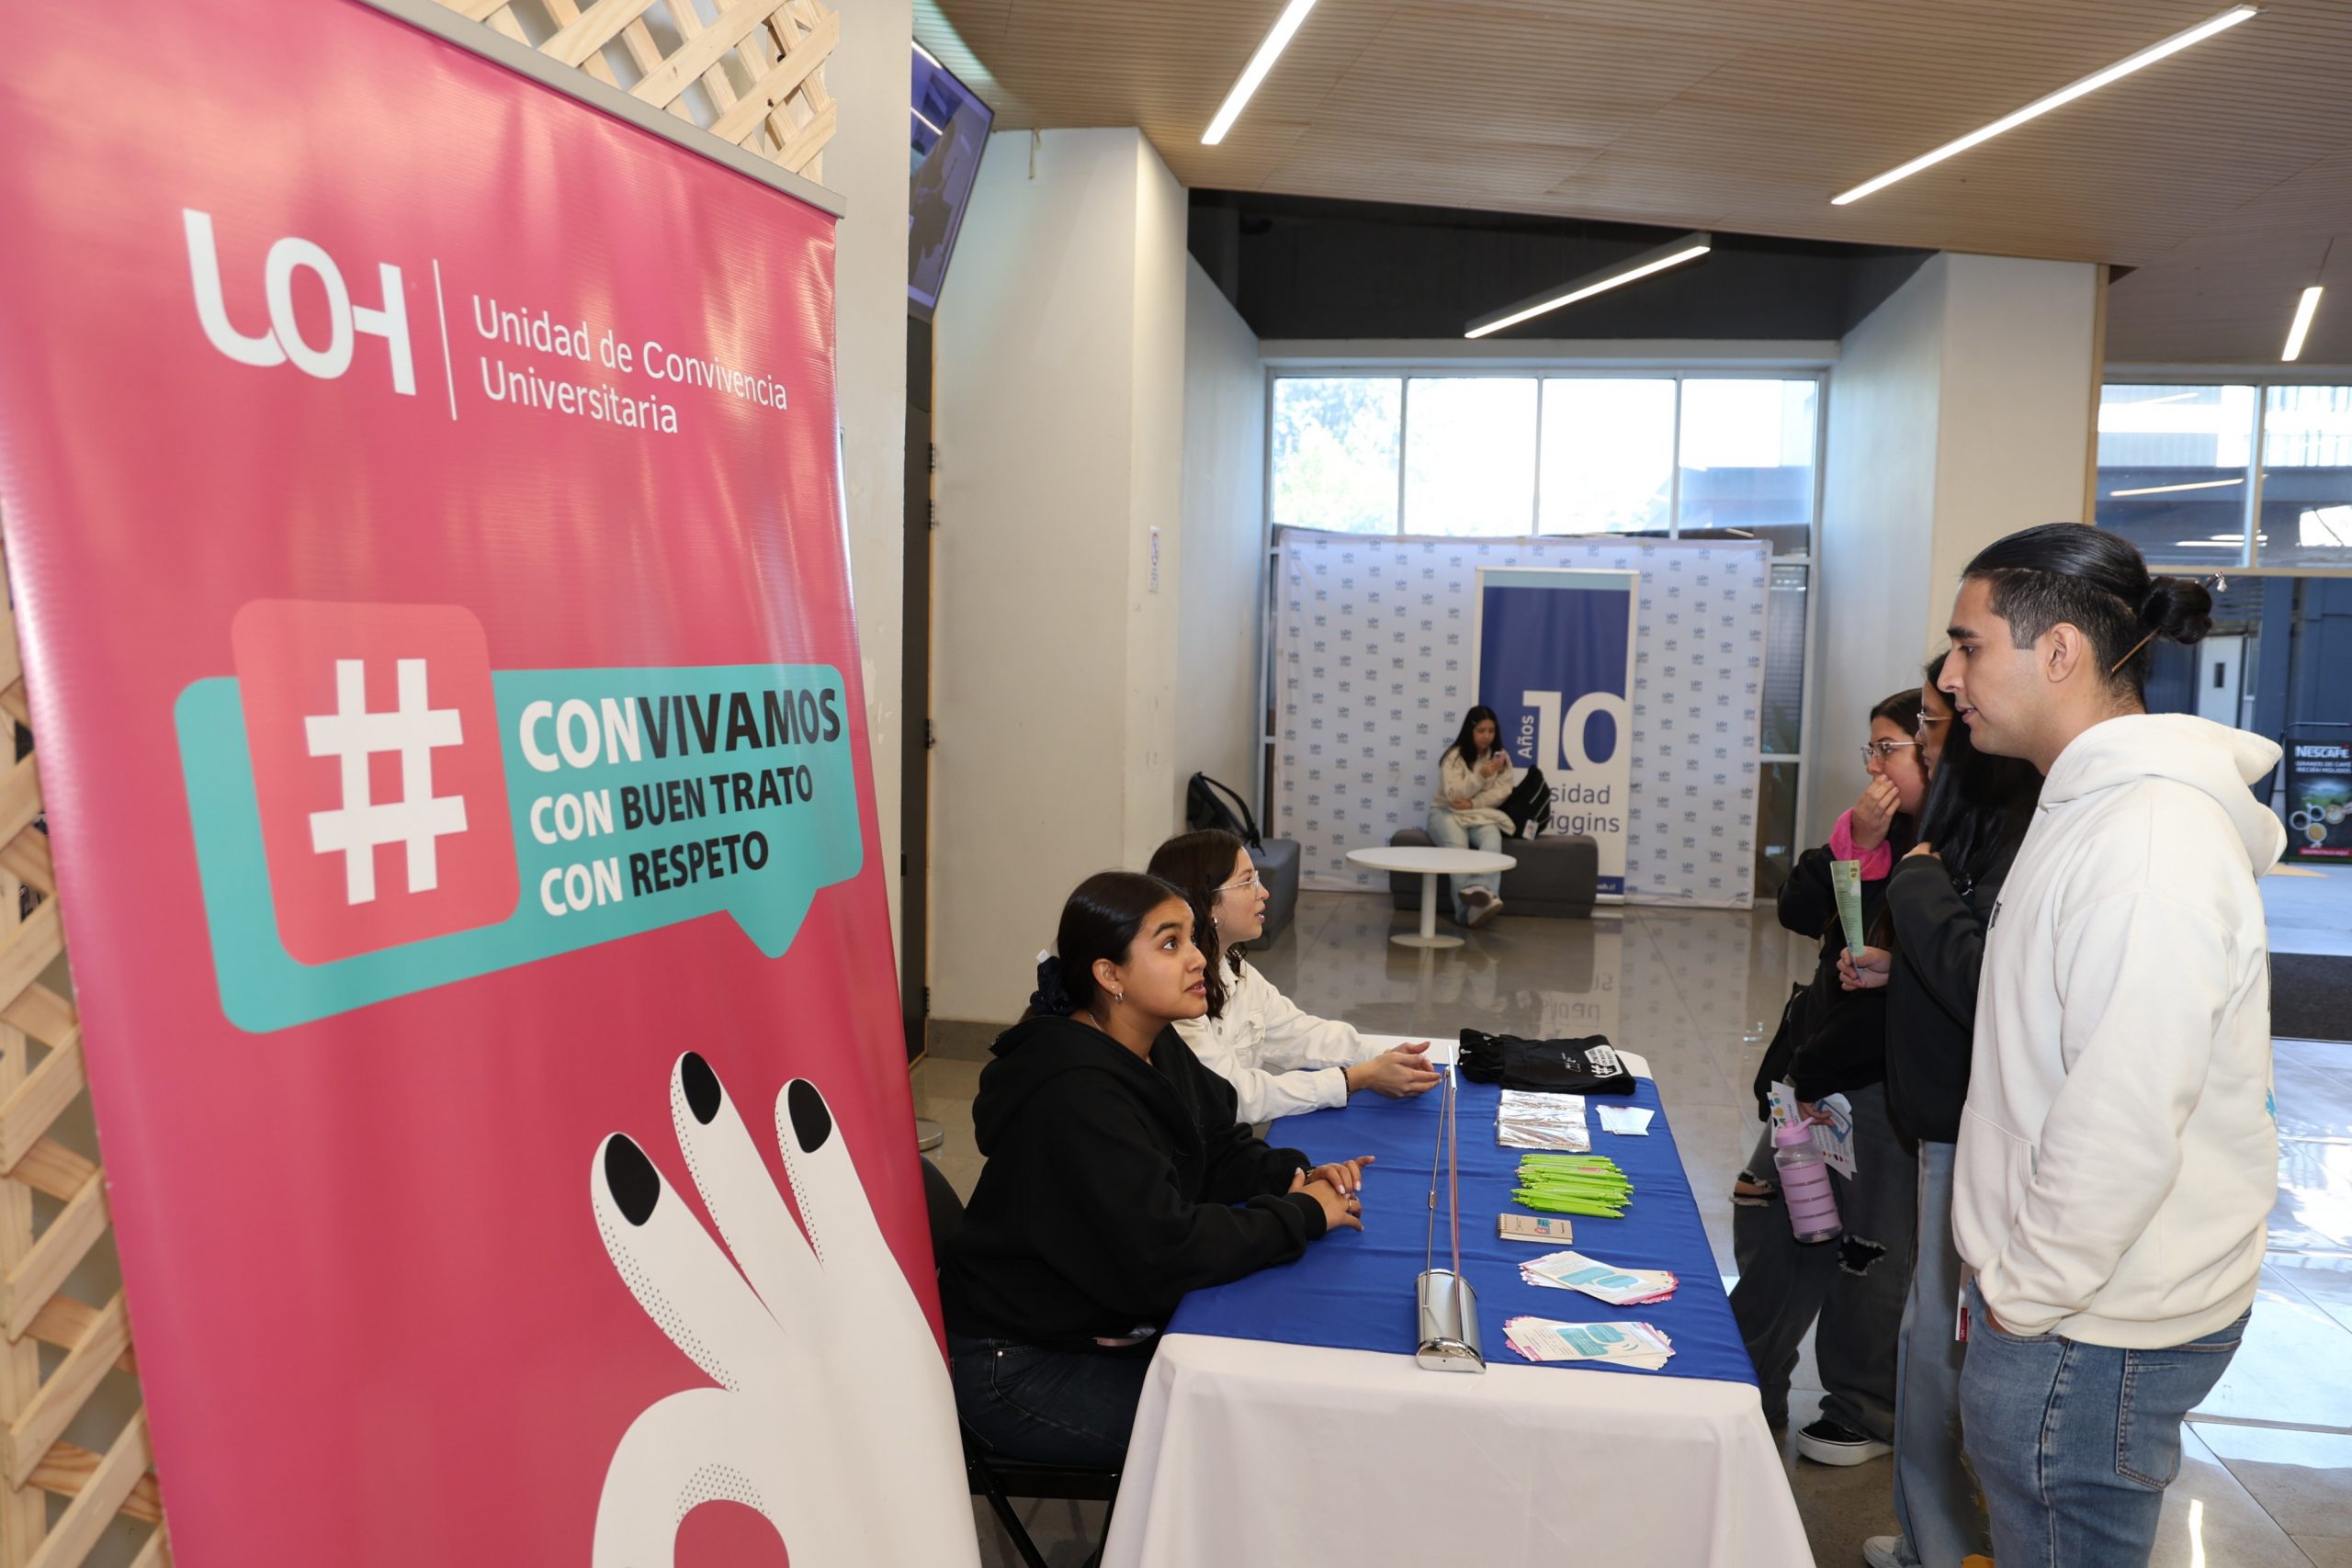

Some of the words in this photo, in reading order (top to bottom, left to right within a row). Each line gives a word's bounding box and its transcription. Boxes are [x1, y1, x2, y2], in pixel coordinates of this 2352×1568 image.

[473, 295, 591, 362] Unidad
[601, 329, 633, 373] de
[643, 342, 787, 410] Convivencia
[480, 356, 679, 434] Universitaria
[519, 688, 841, 772] CONVIVAMOS
[1517, 715, 1534, 760] Años
[1523, 691, 1626, 772] 10
[530, 789, 614, 844] CON
[620, 777, 707, 830] BUEN
[709, 764, 813, 816] TRATO
[1550, 783, 1611, 805] sidad
[1550, 810, 1620, 835] iggins
[540, 857, 623, 916] CON
[629, 830, 769, 897] RESPETO
